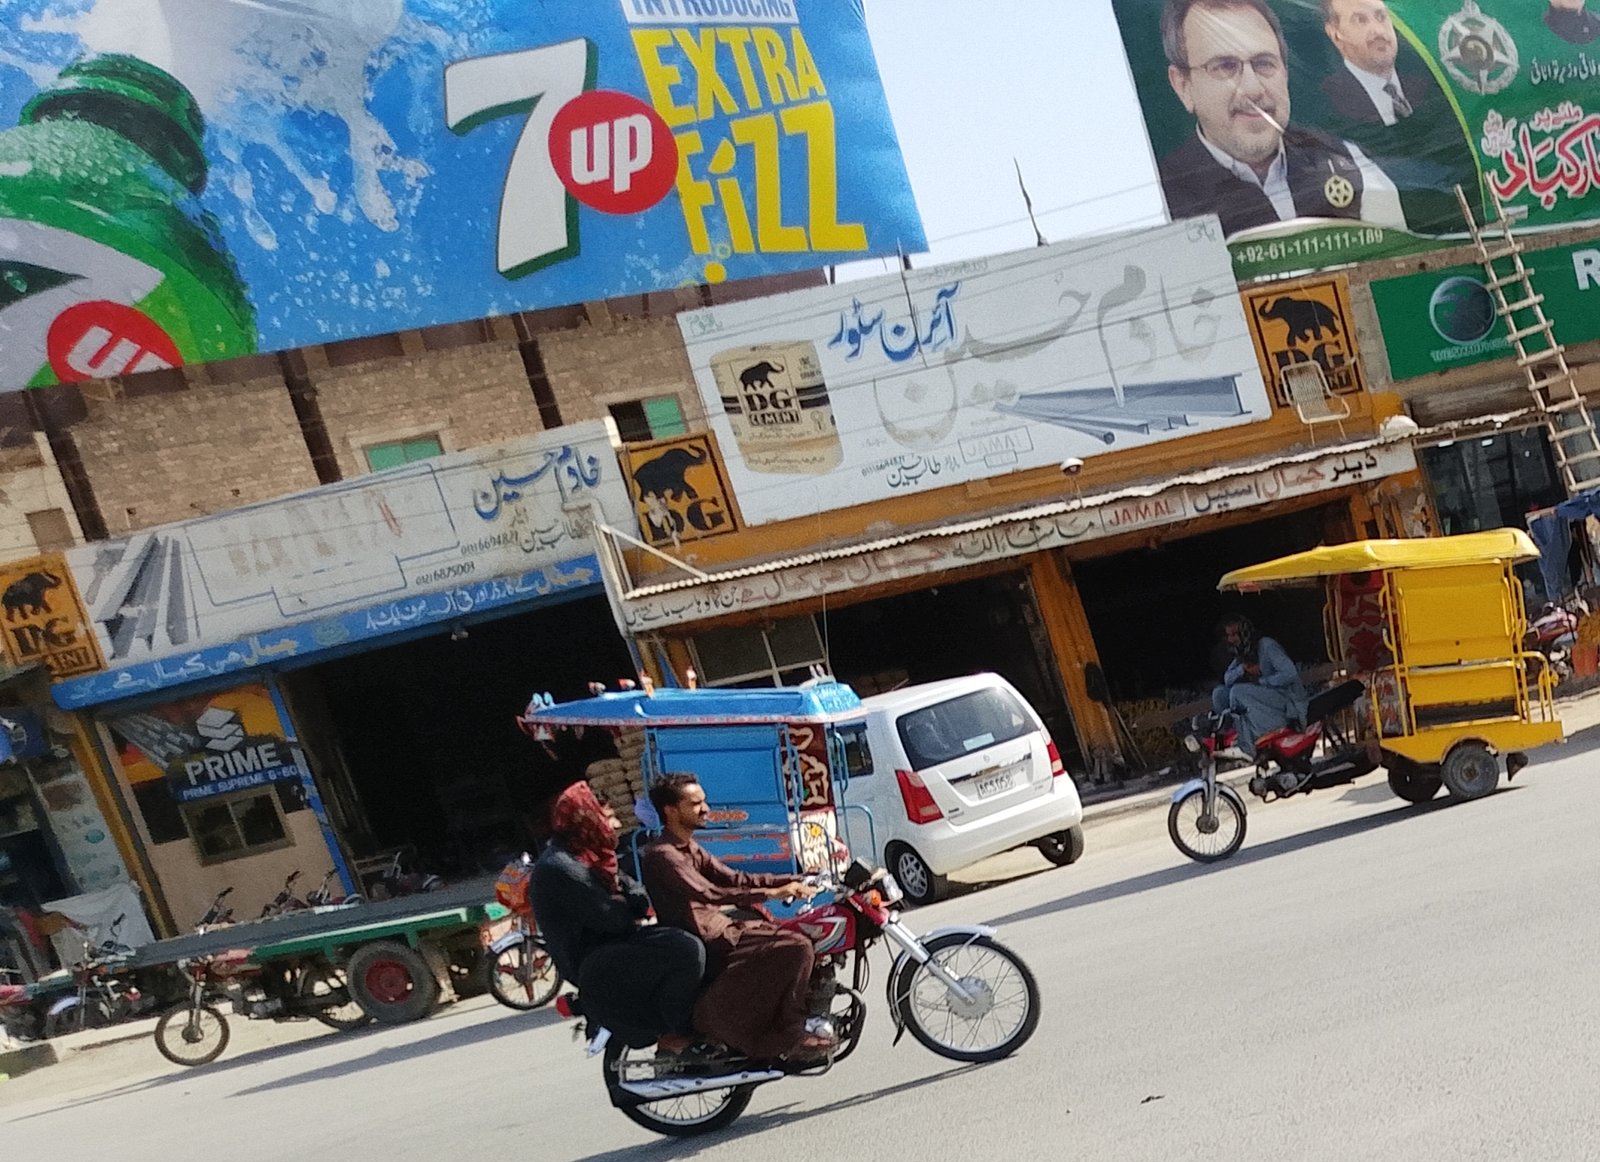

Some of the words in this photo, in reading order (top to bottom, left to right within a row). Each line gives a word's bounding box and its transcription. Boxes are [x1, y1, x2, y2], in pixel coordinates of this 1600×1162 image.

[630, 27, 828, 127] EXTRA
[1236, 228, 1385, 264] +92-61-111-111-189
[743, 389, 793, 412] DG
[749, 410, 801, 427] CEMENT
[643, 496, 726, 541] DG
[1109, 500, 1177, 527] JAMAL
[10, 616, 77, 657] DG
[185, 743, 282, 785] PRIME
[183, 784, 216, 799] PRIME
[217, 773, 264, 790] SUPREME
